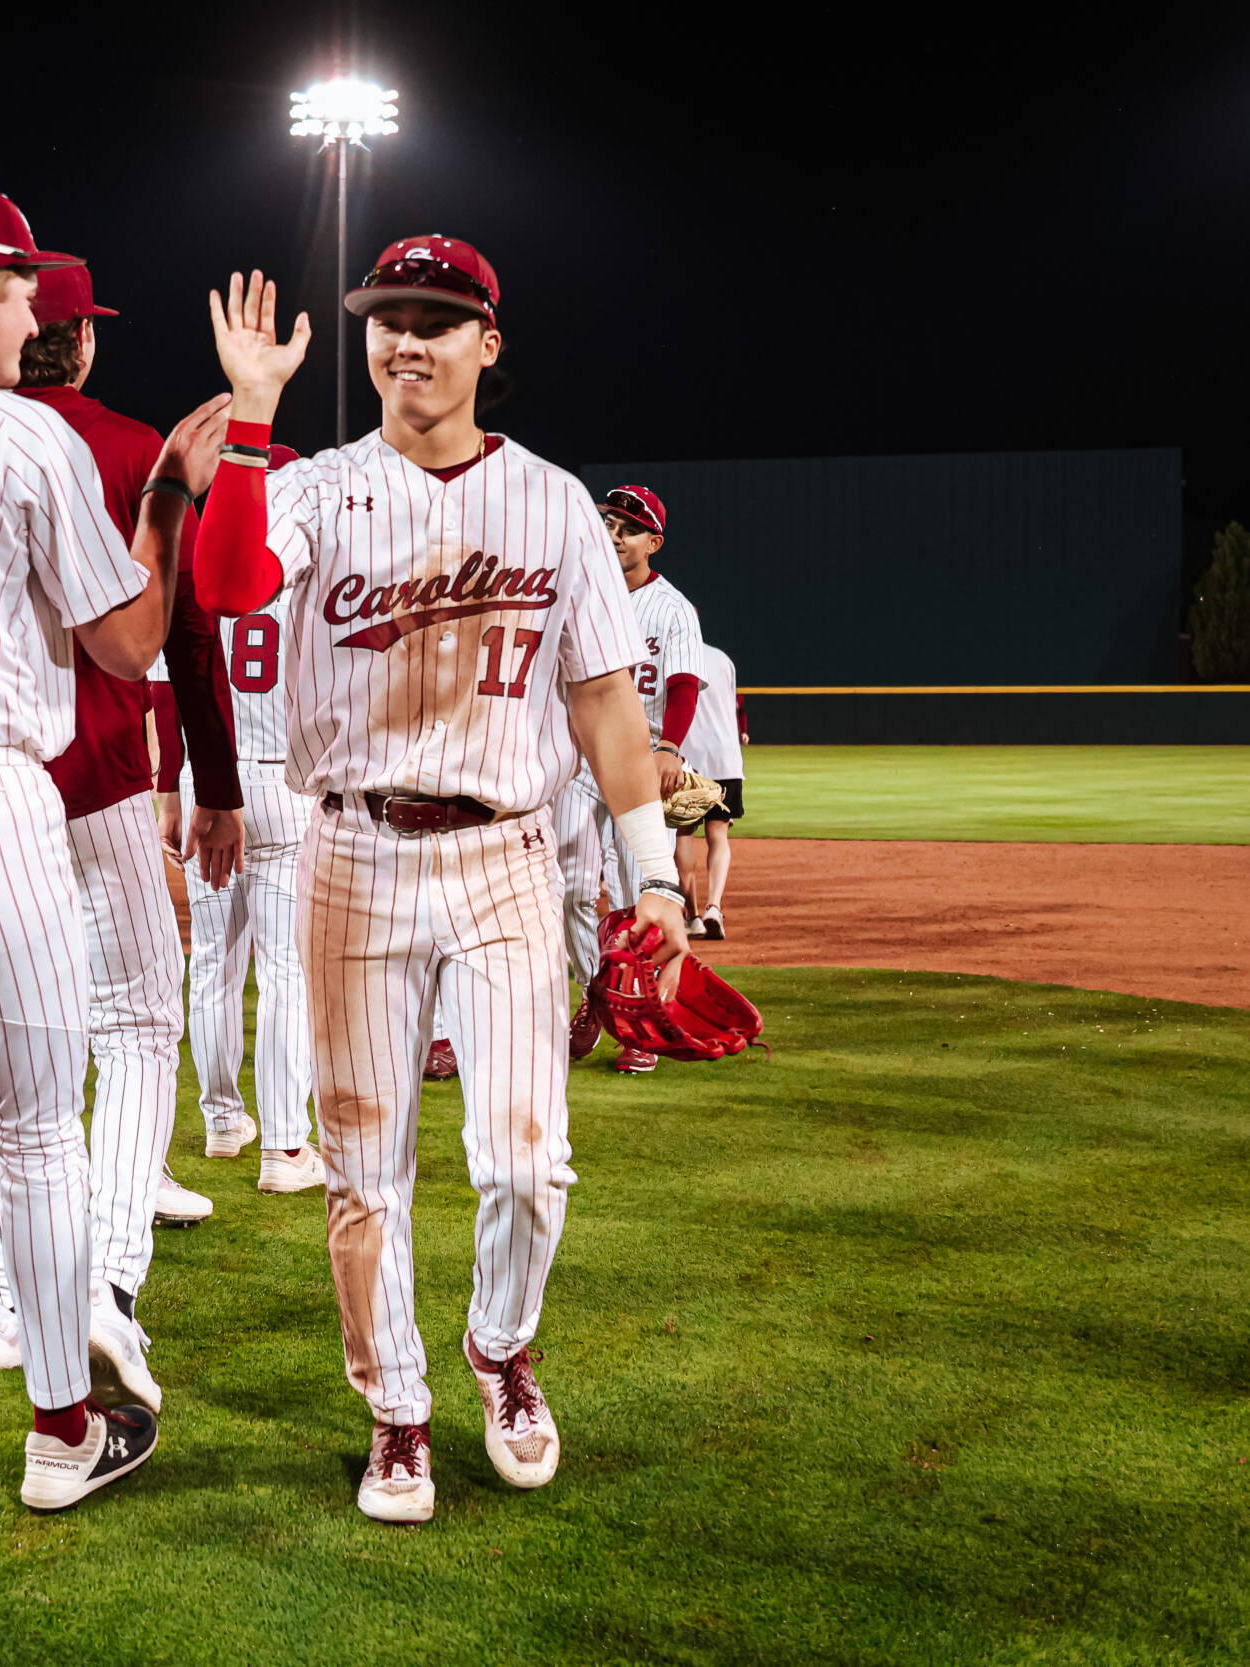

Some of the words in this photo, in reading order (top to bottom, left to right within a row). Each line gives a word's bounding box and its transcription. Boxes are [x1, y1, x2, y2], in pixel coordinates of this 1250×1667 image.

[323, 550, 558, 626] Carolina
[230, 613, 280, 694] 8
[477, 625, 545, 699] 17
[34, 1458, 80, 1471] ARMOUR
